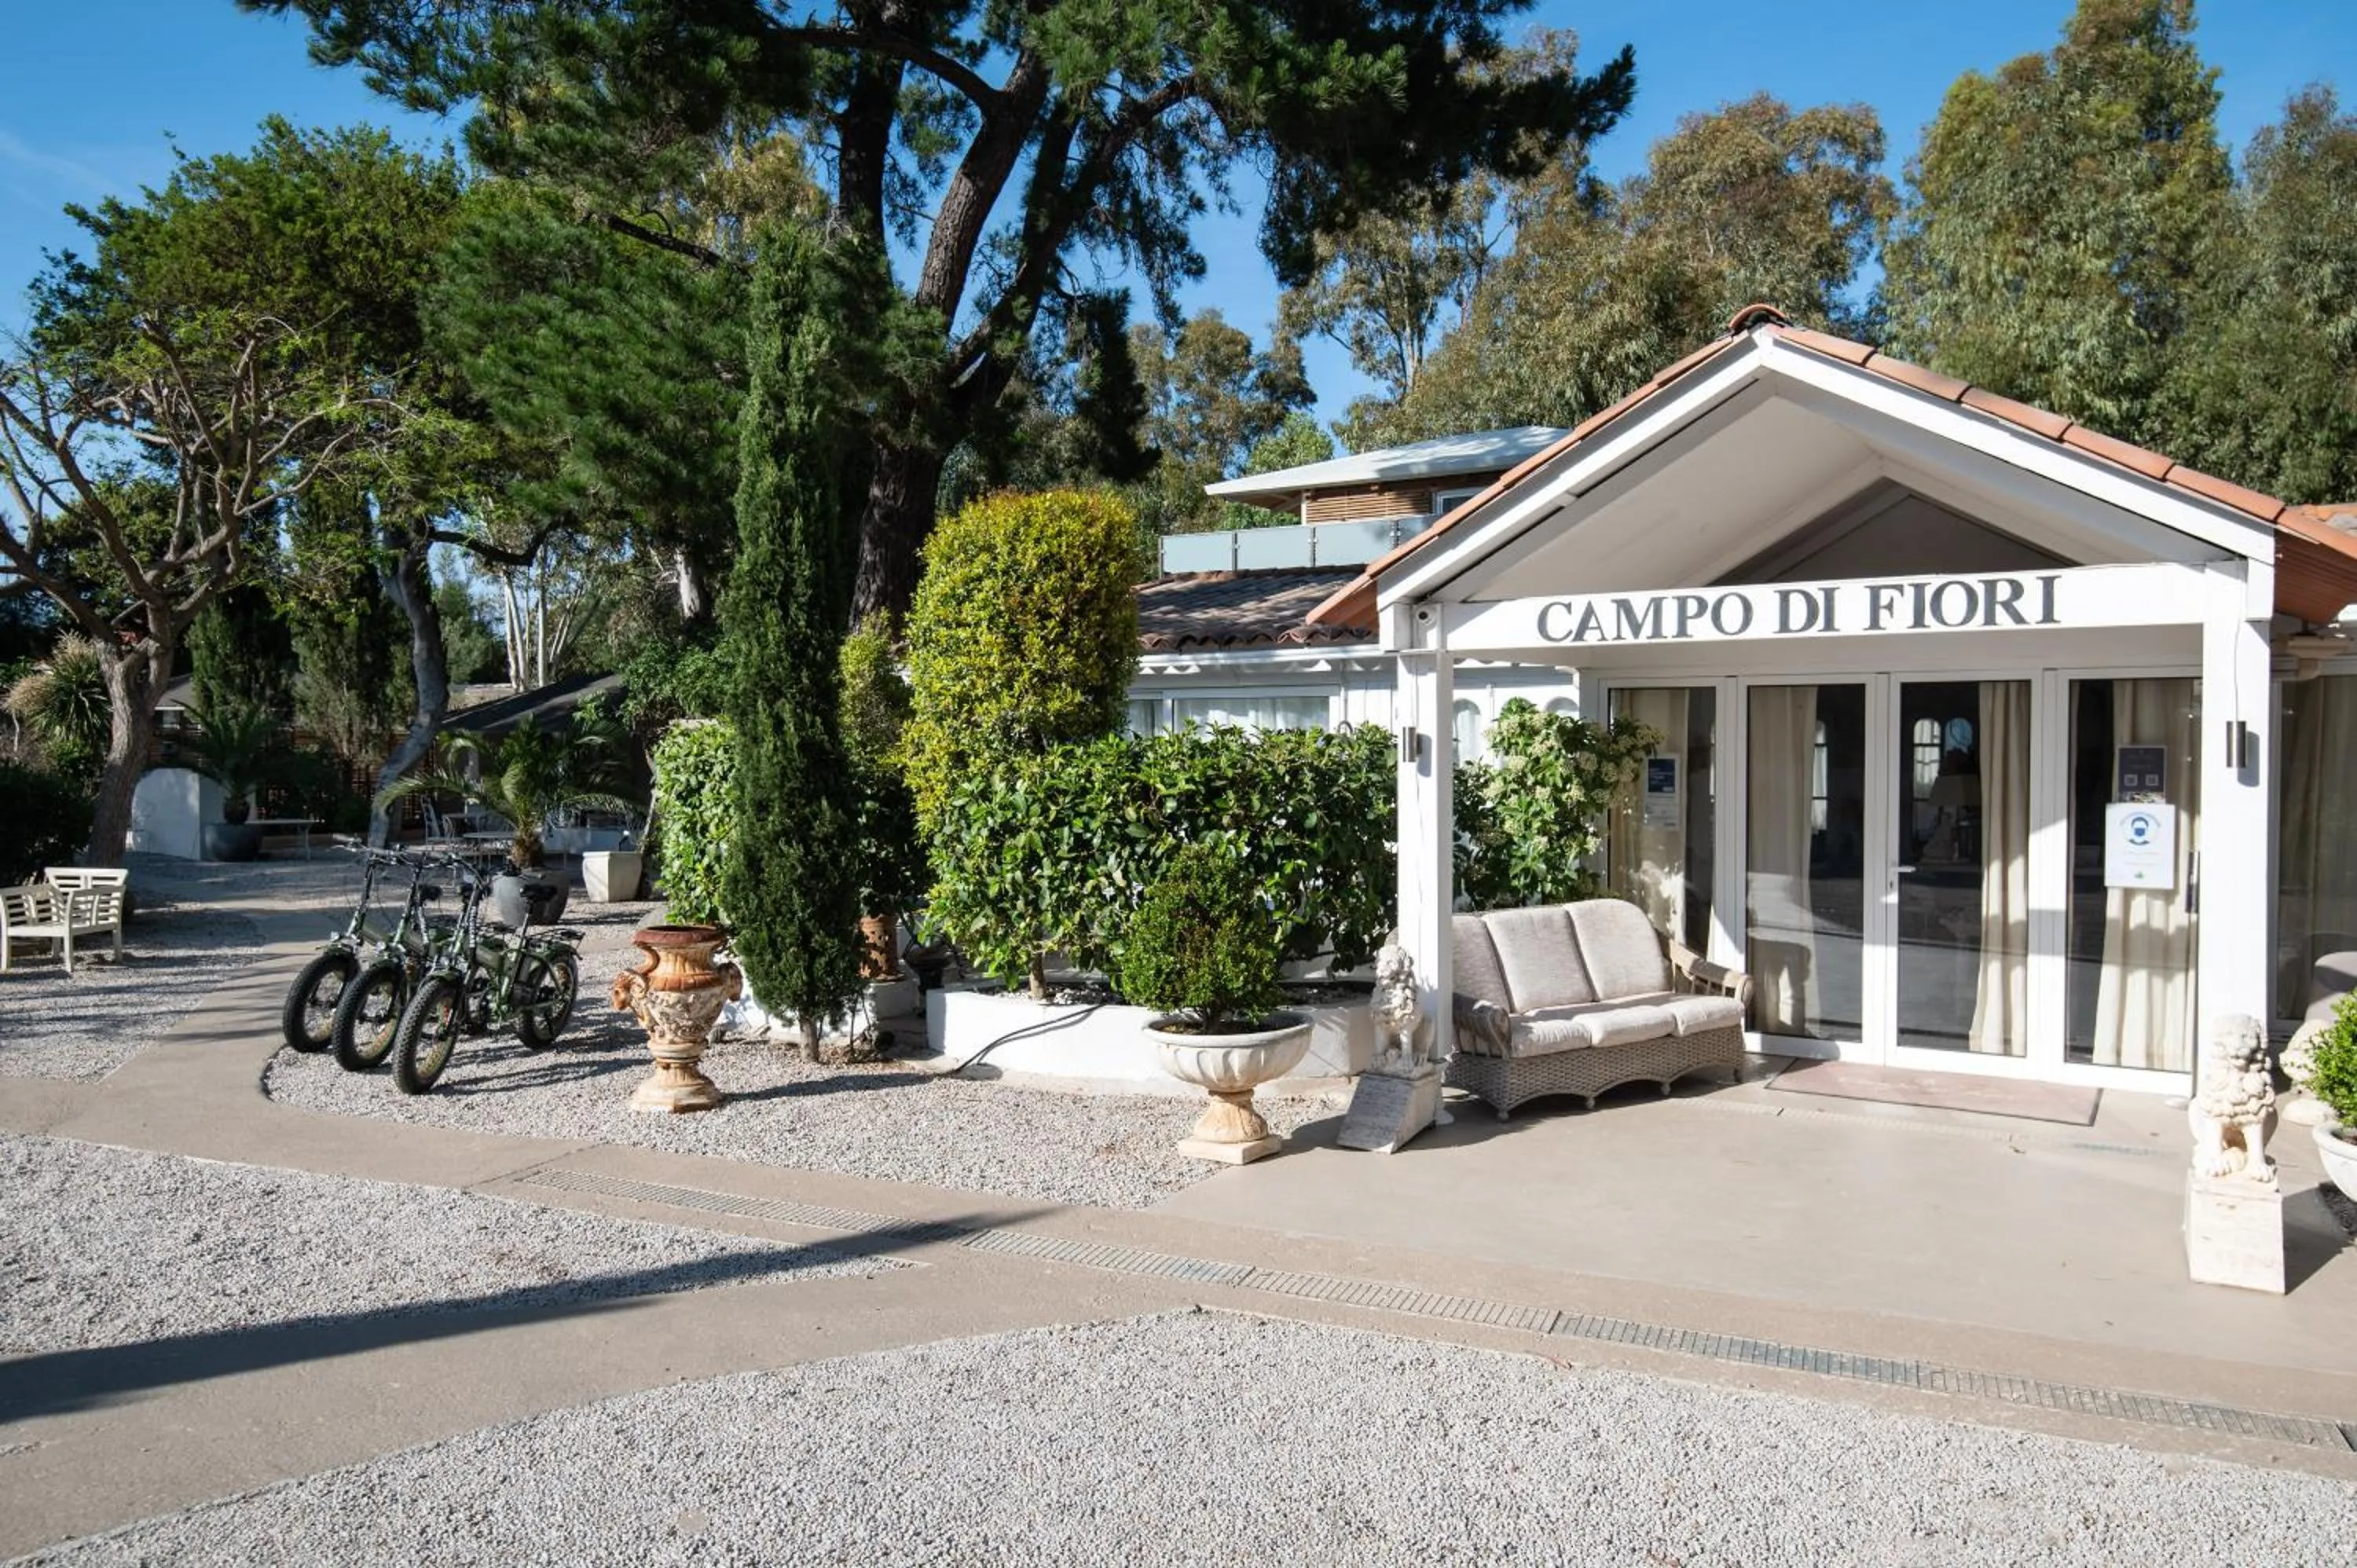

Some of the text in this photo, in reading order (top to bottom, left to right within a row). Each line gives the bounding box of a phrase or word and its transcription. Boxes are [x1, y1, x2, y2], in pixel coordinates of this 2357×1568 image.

[1537, 575, 2062, 642] CAMPO DI FIORI
